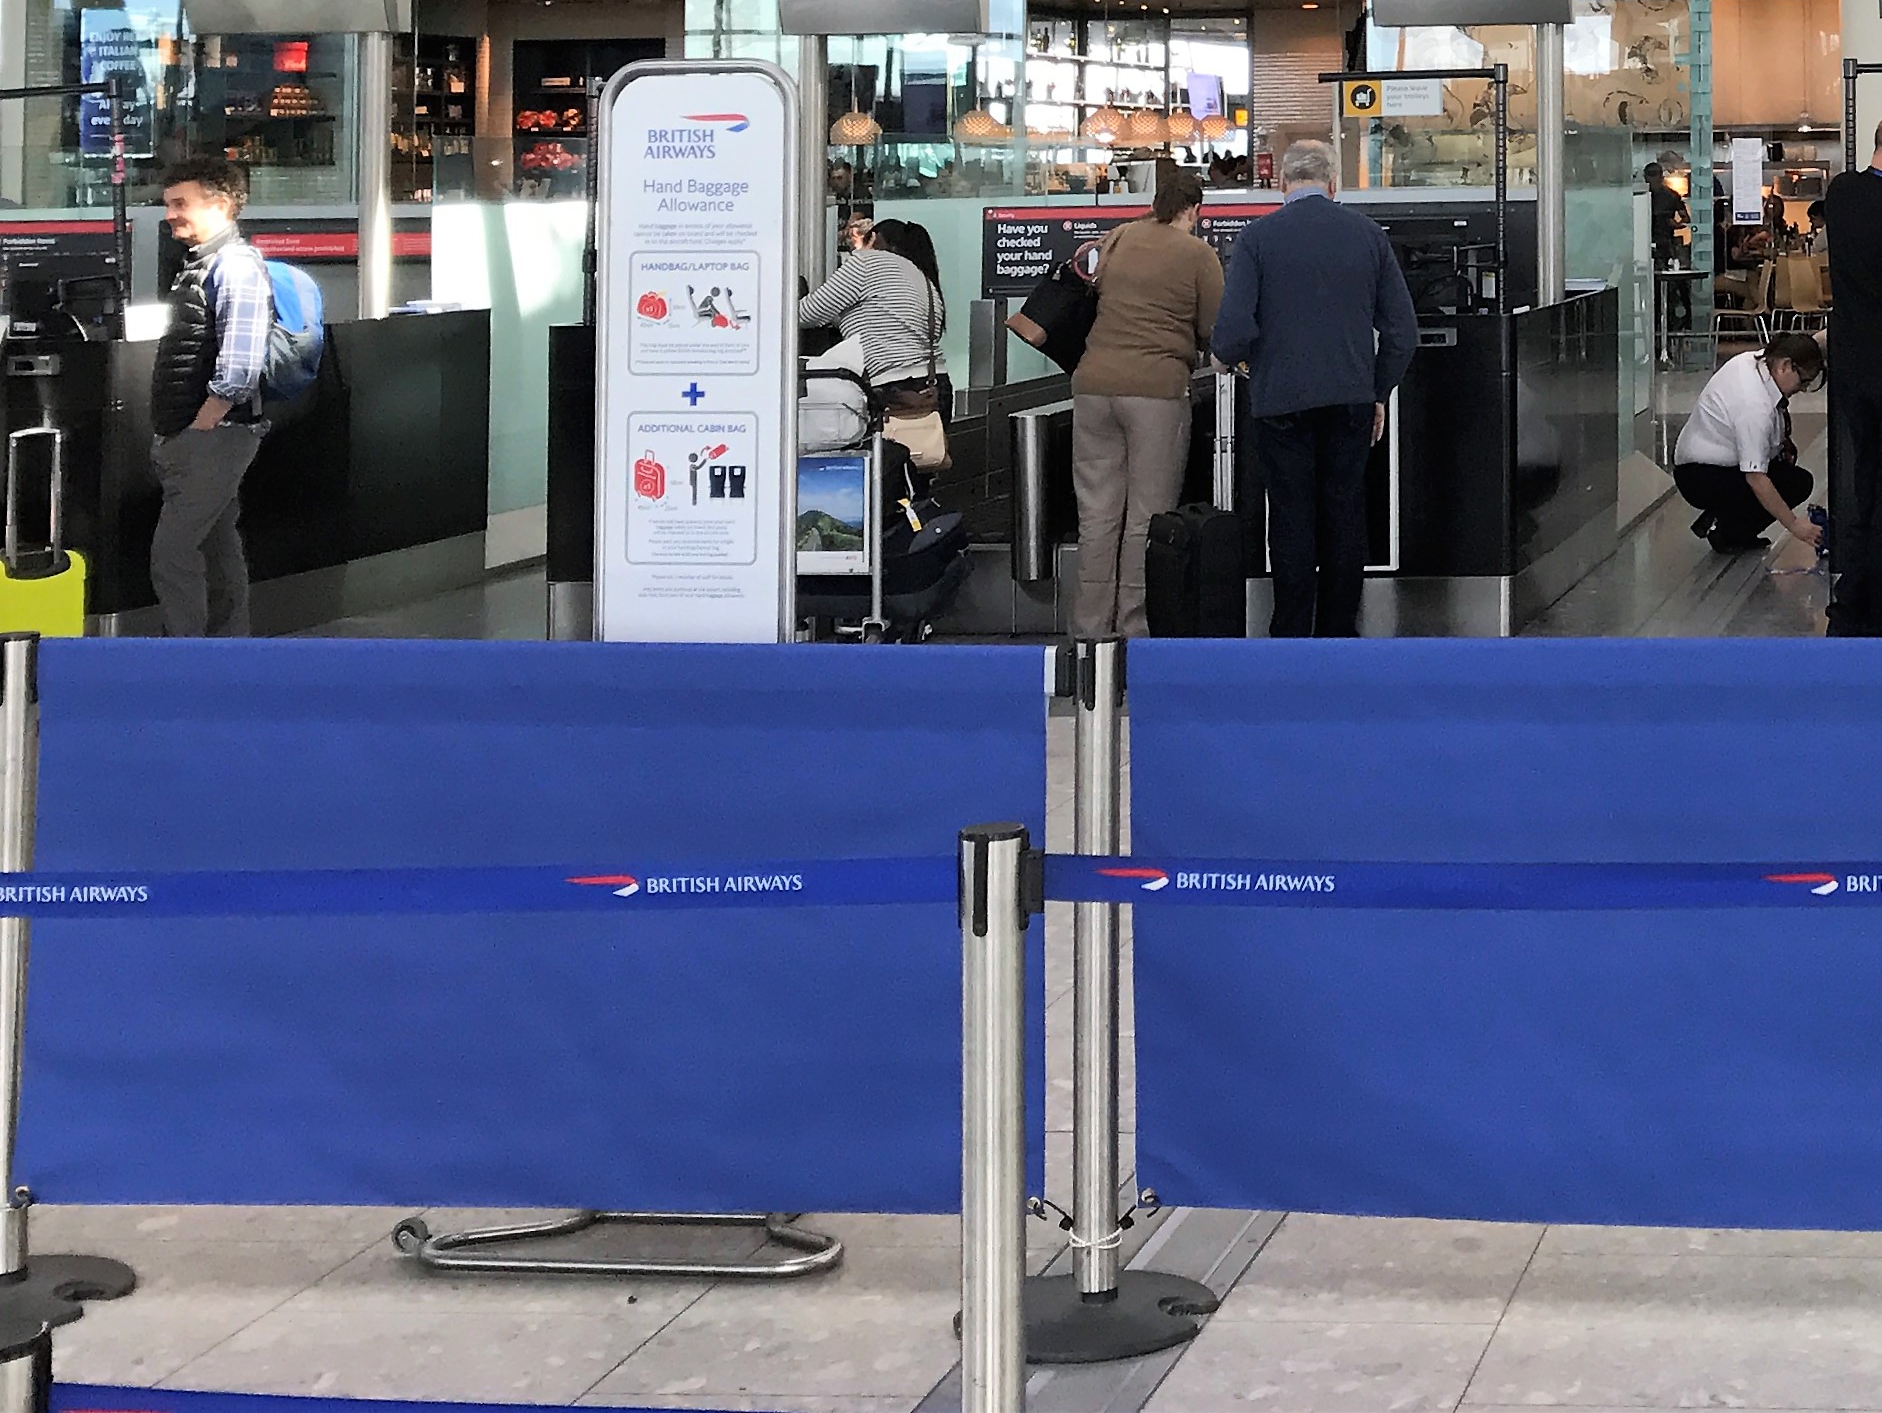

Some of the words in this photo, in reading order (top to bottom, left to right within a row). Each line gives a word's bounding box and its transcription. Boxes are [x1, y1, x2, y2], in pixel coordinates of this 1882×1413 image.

[647, 129, 714, 143] BRITISH
[643, 145, 716, 159] AIRWAYS
[643, 179, 683, 193] Hand
[687, 179, 749, 196] Baggage
[657, 198, 734, 212] Allowance
[998, 223, 1025, 234] Have
[1027, 224, 1048, 236] you
[997, 237, 1041, 248] checked
[997, 251, 1024, 263] your
[1024, 250, 1052, 261] hand
[641, 263, 728, 272] HANDBAG/LAPTOP
[730, 262, 750, 271] BAG
[997, 263, 1050, 277] baggage?
[637, 424, 695, 433] ADDITIONAL
[697, 424, 725, 433] CABIN
[727, 424, 747, 433] BAG
[646, 876, 720, 894] BRITISH
[723, 874, 803, 892] AIRWAYS
[1176, 872, 1250, 890] BRITISH
[1254, 874, 1336, 892] AIRWAYS
[69, 886, 148, 903] AIRWAYS
